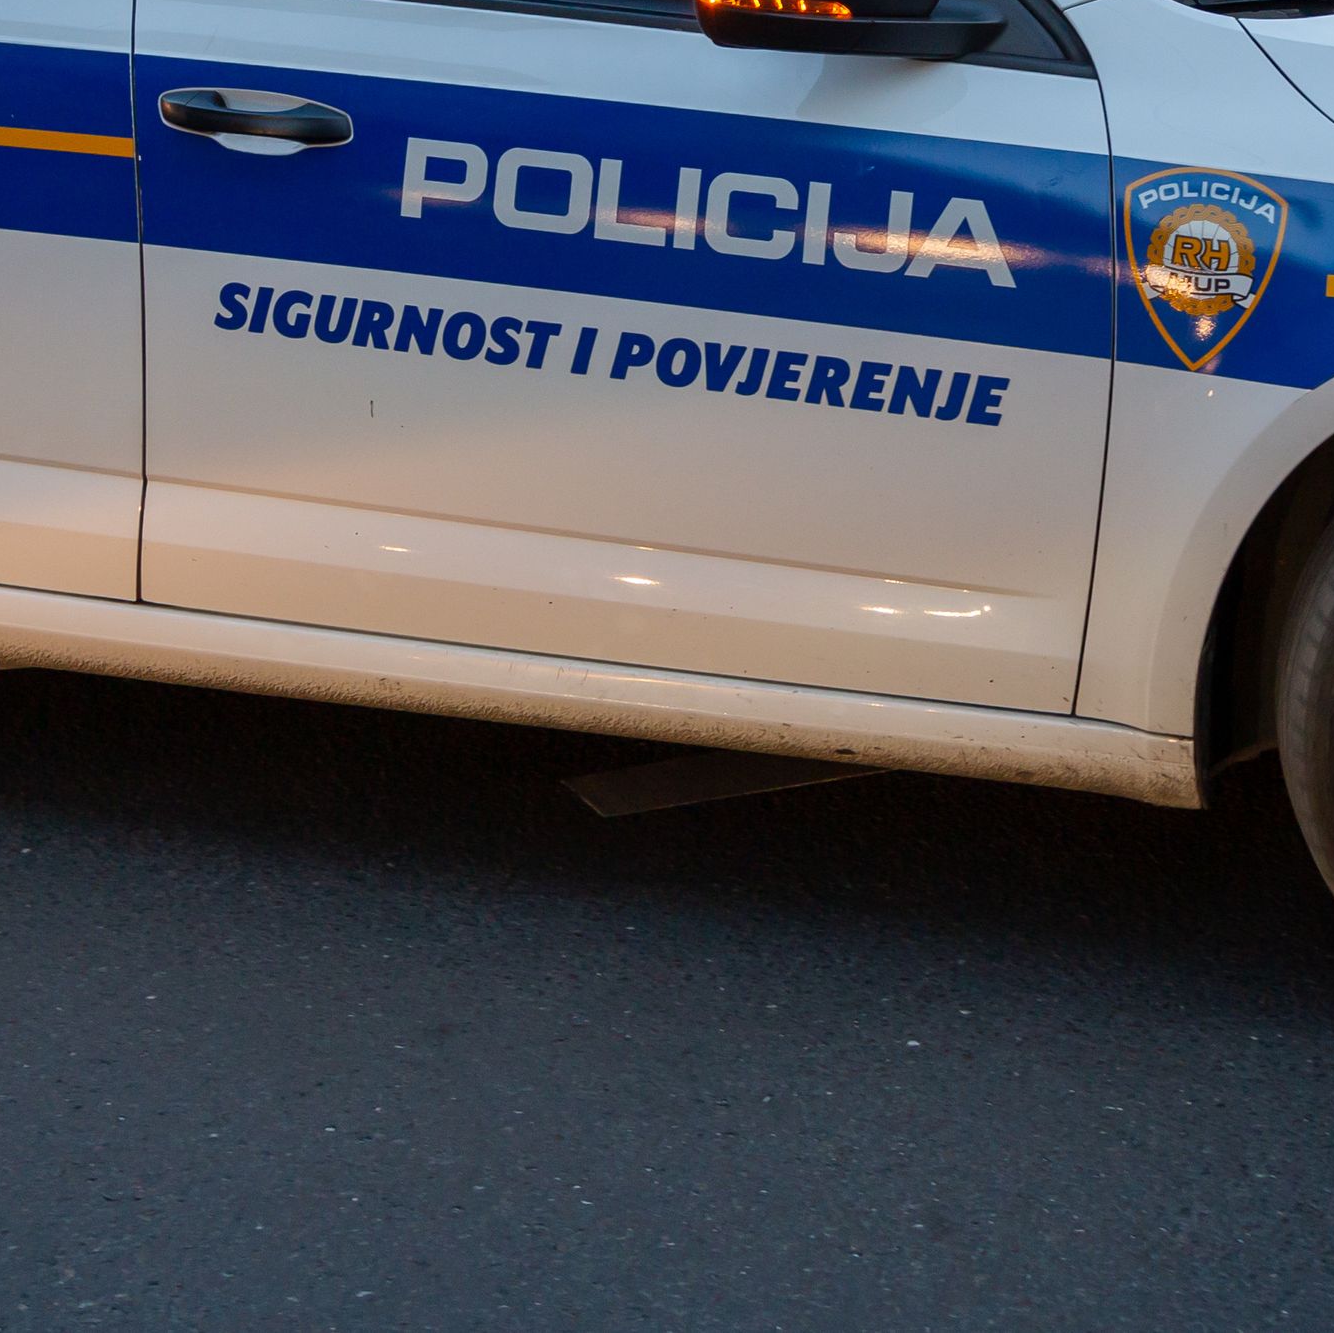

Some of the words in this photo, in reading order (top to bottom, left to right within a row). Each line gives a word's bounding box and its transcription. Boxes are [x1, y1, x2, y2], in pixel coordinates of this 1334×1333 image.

[400, 136, 1016, 289] POLICIJA
[1138, 181, 1276, 225] POLICIJA
[1172, 234, 1232, 272] RH
[214, 281, 561, 370] SIGURNOST
[570, 328, 595, 375] I
[609, 331, 1010, 427] POVJERENJE
